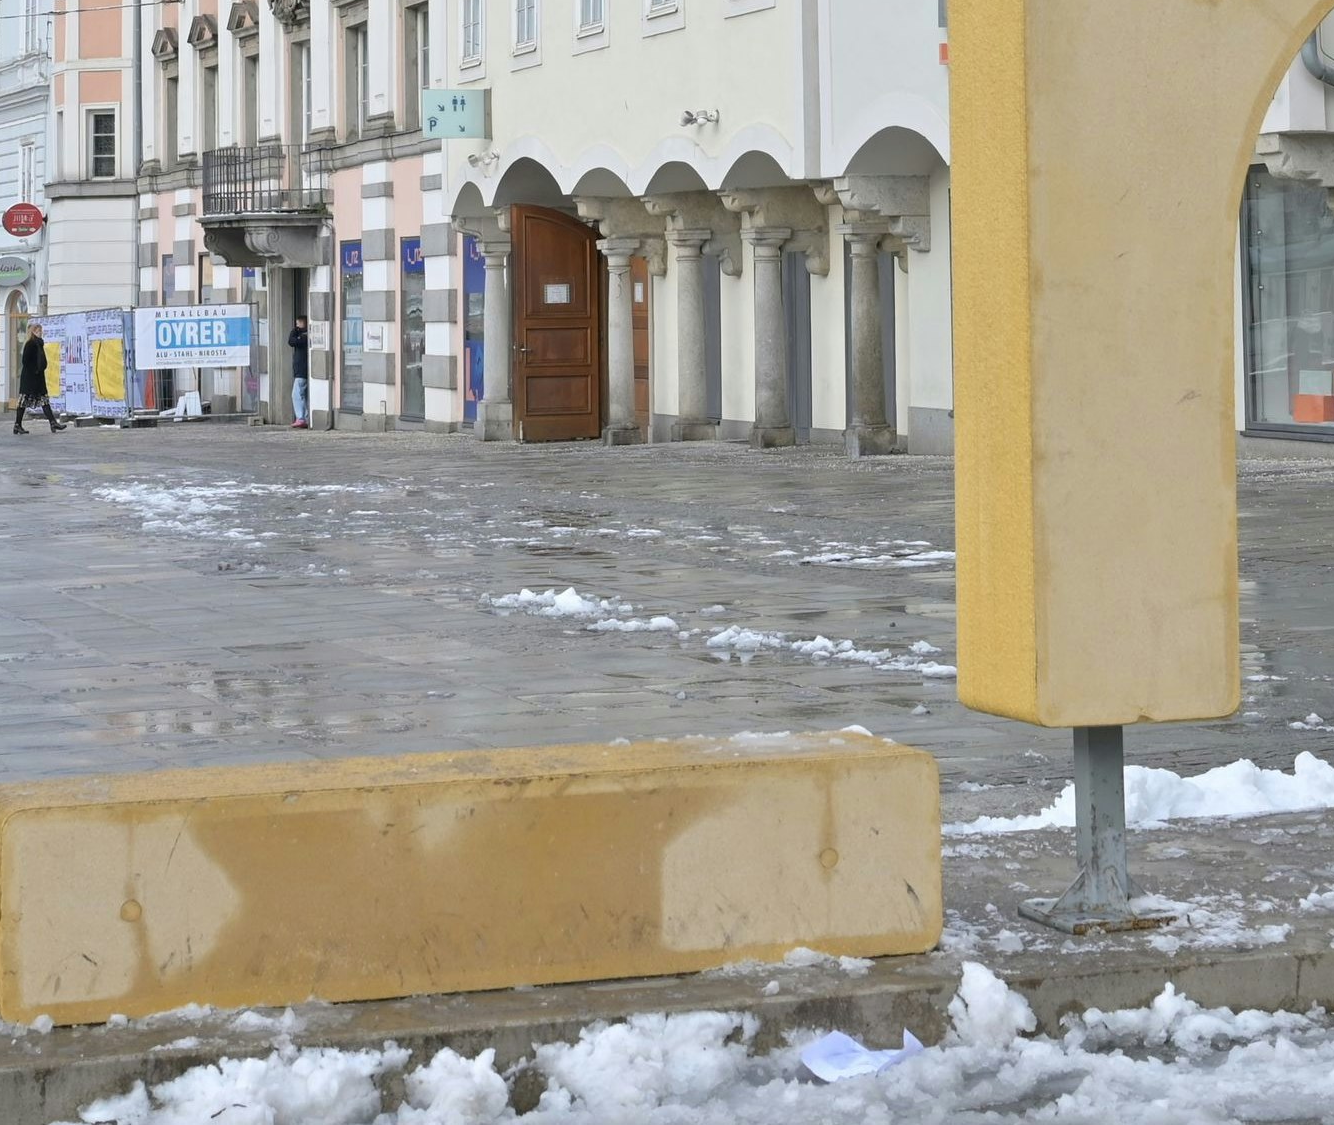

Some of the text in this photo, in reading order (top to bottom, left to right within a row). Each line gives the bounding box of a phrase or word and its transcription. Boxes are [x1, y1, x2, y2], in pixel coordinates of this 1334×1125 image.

[155, 309, 227, 318] METALLBAU
[157, 320, 227, 347] OYRER
[156, 350, 168, 358] ALU
[198, 349, 227, 357] NIROSTA
